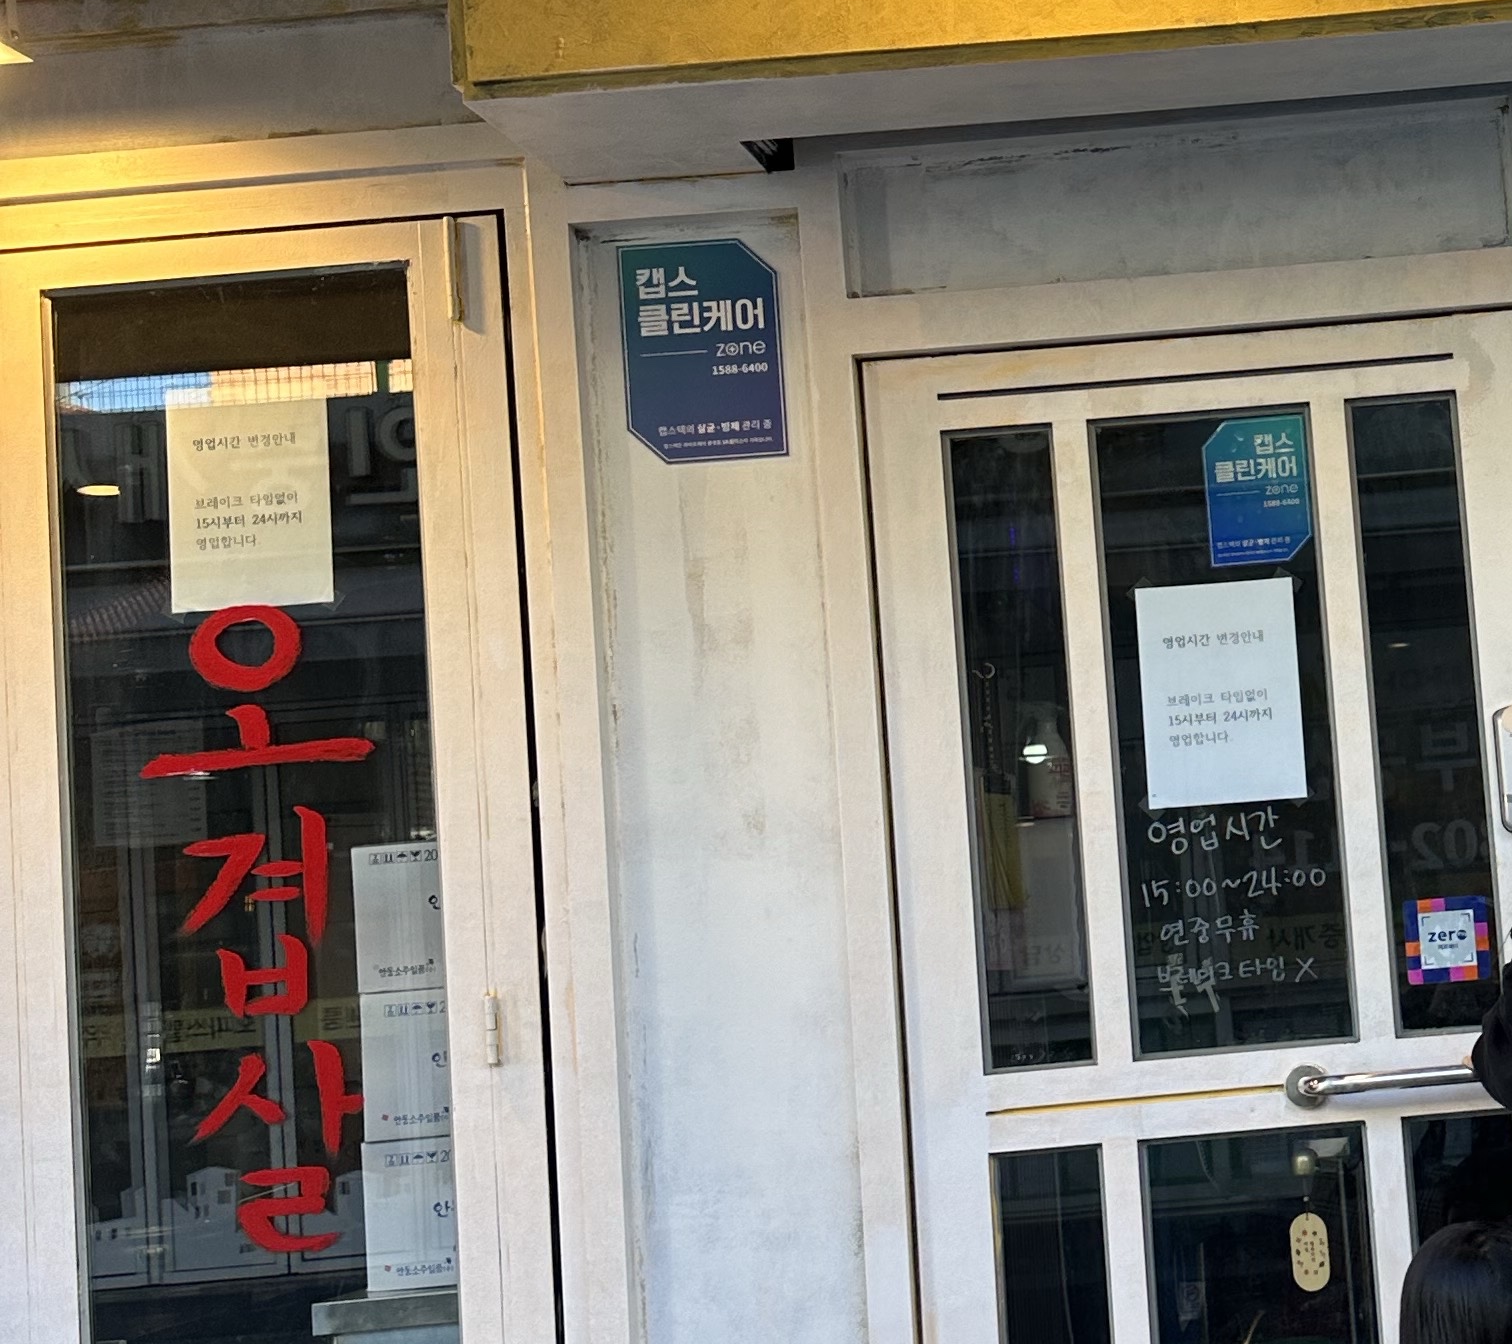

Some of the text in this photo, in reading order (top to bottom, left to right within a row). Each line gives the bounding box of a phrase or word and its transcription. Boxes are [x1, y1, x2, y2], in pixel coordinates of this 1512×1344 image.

[636, 266, 699, 300] 캡스
[637, 297, 765, 337] 클린케어
[716, 340, 766, 357] zone
[712, 362, 769, 376] 1588-6400
[193, 432, 296, 451] 영업시간 변경안내
[1254, 432, 1295, 455] 캡스
[1214, 455, 1297, 483] 클린케어
[196, 510, 303, 530] 15시부터 24시까지
[1162, 629, 1264, 649] 영업시간 변경안내
[1166, 688, 1268, 707] 브레이크 타임없이
[1168, 707, 1273, 727] 15시부터 24시까지
[1147, 805, 1283, 855] 영업시간
[1141, 866, 1326, 907] 15:00~24:00
[140, 604, 375, 1252] 오겹살
[1160, 908, 1260, 946] 연중무휴
[1428, 929, 1467, 943] zero
